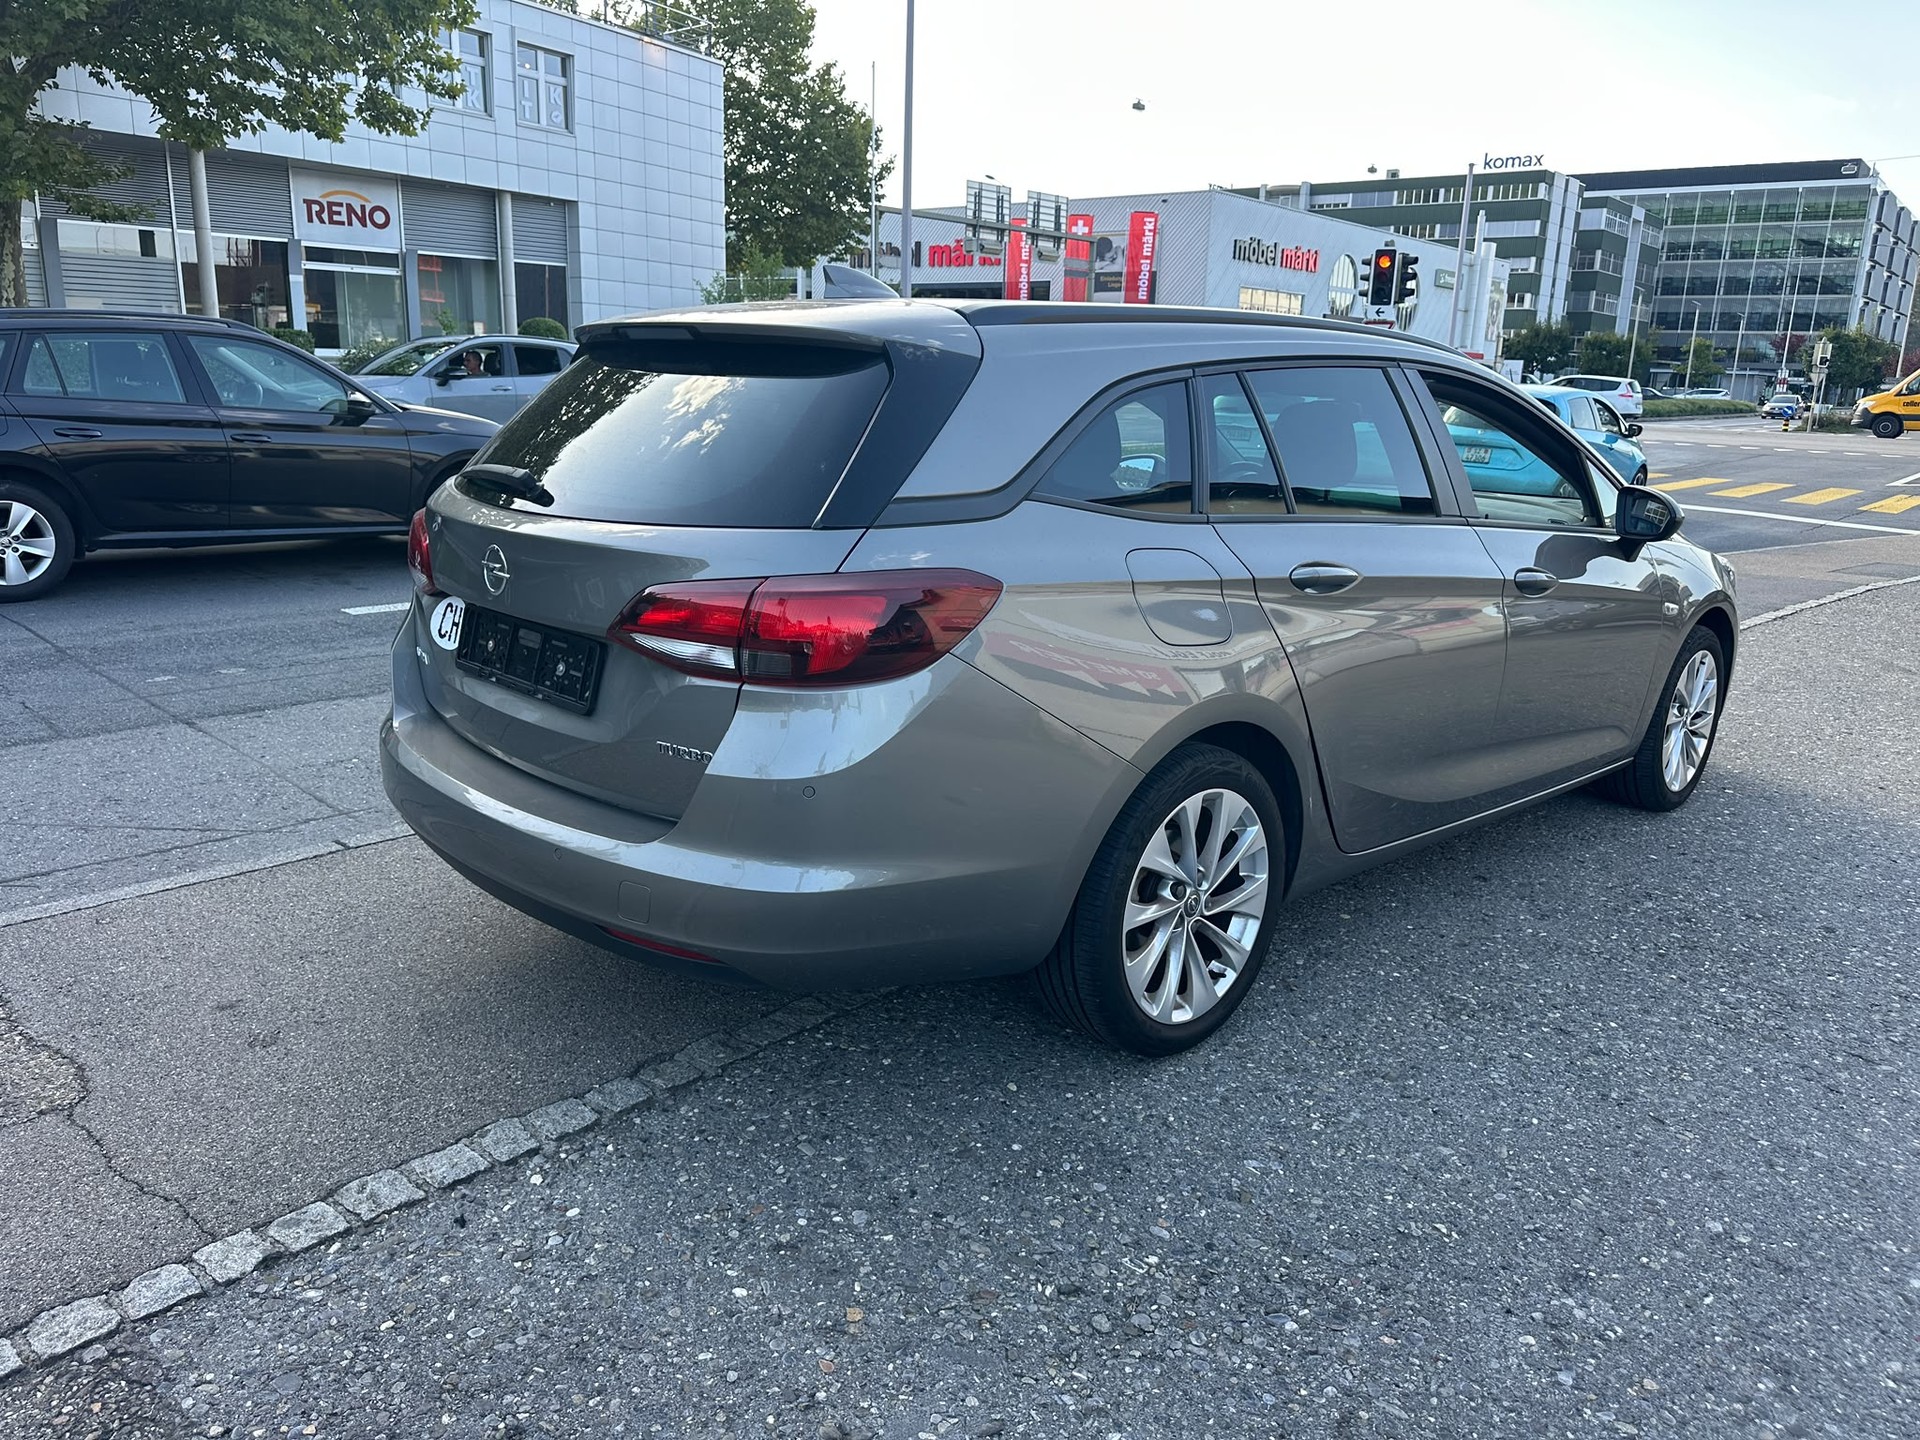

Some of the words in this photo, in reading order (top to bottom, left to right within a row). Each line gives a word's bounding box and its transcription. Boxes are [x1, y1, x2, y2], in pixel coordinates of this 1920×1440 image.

[1483, 153, 1544, 170] komax
[302, 198, 391, 230] RENO
[1142, 217, 1155, 256] märki
[1233, 237, 1279, 266] möbel
[1280, 246, 1319, 273] märki
[1018, 263, 1028, 301] möbel
[1138, 259, 1151, 300] möbel
[437, 602, 463, 644] CH
[656, 740, 714, 764] TURBO
